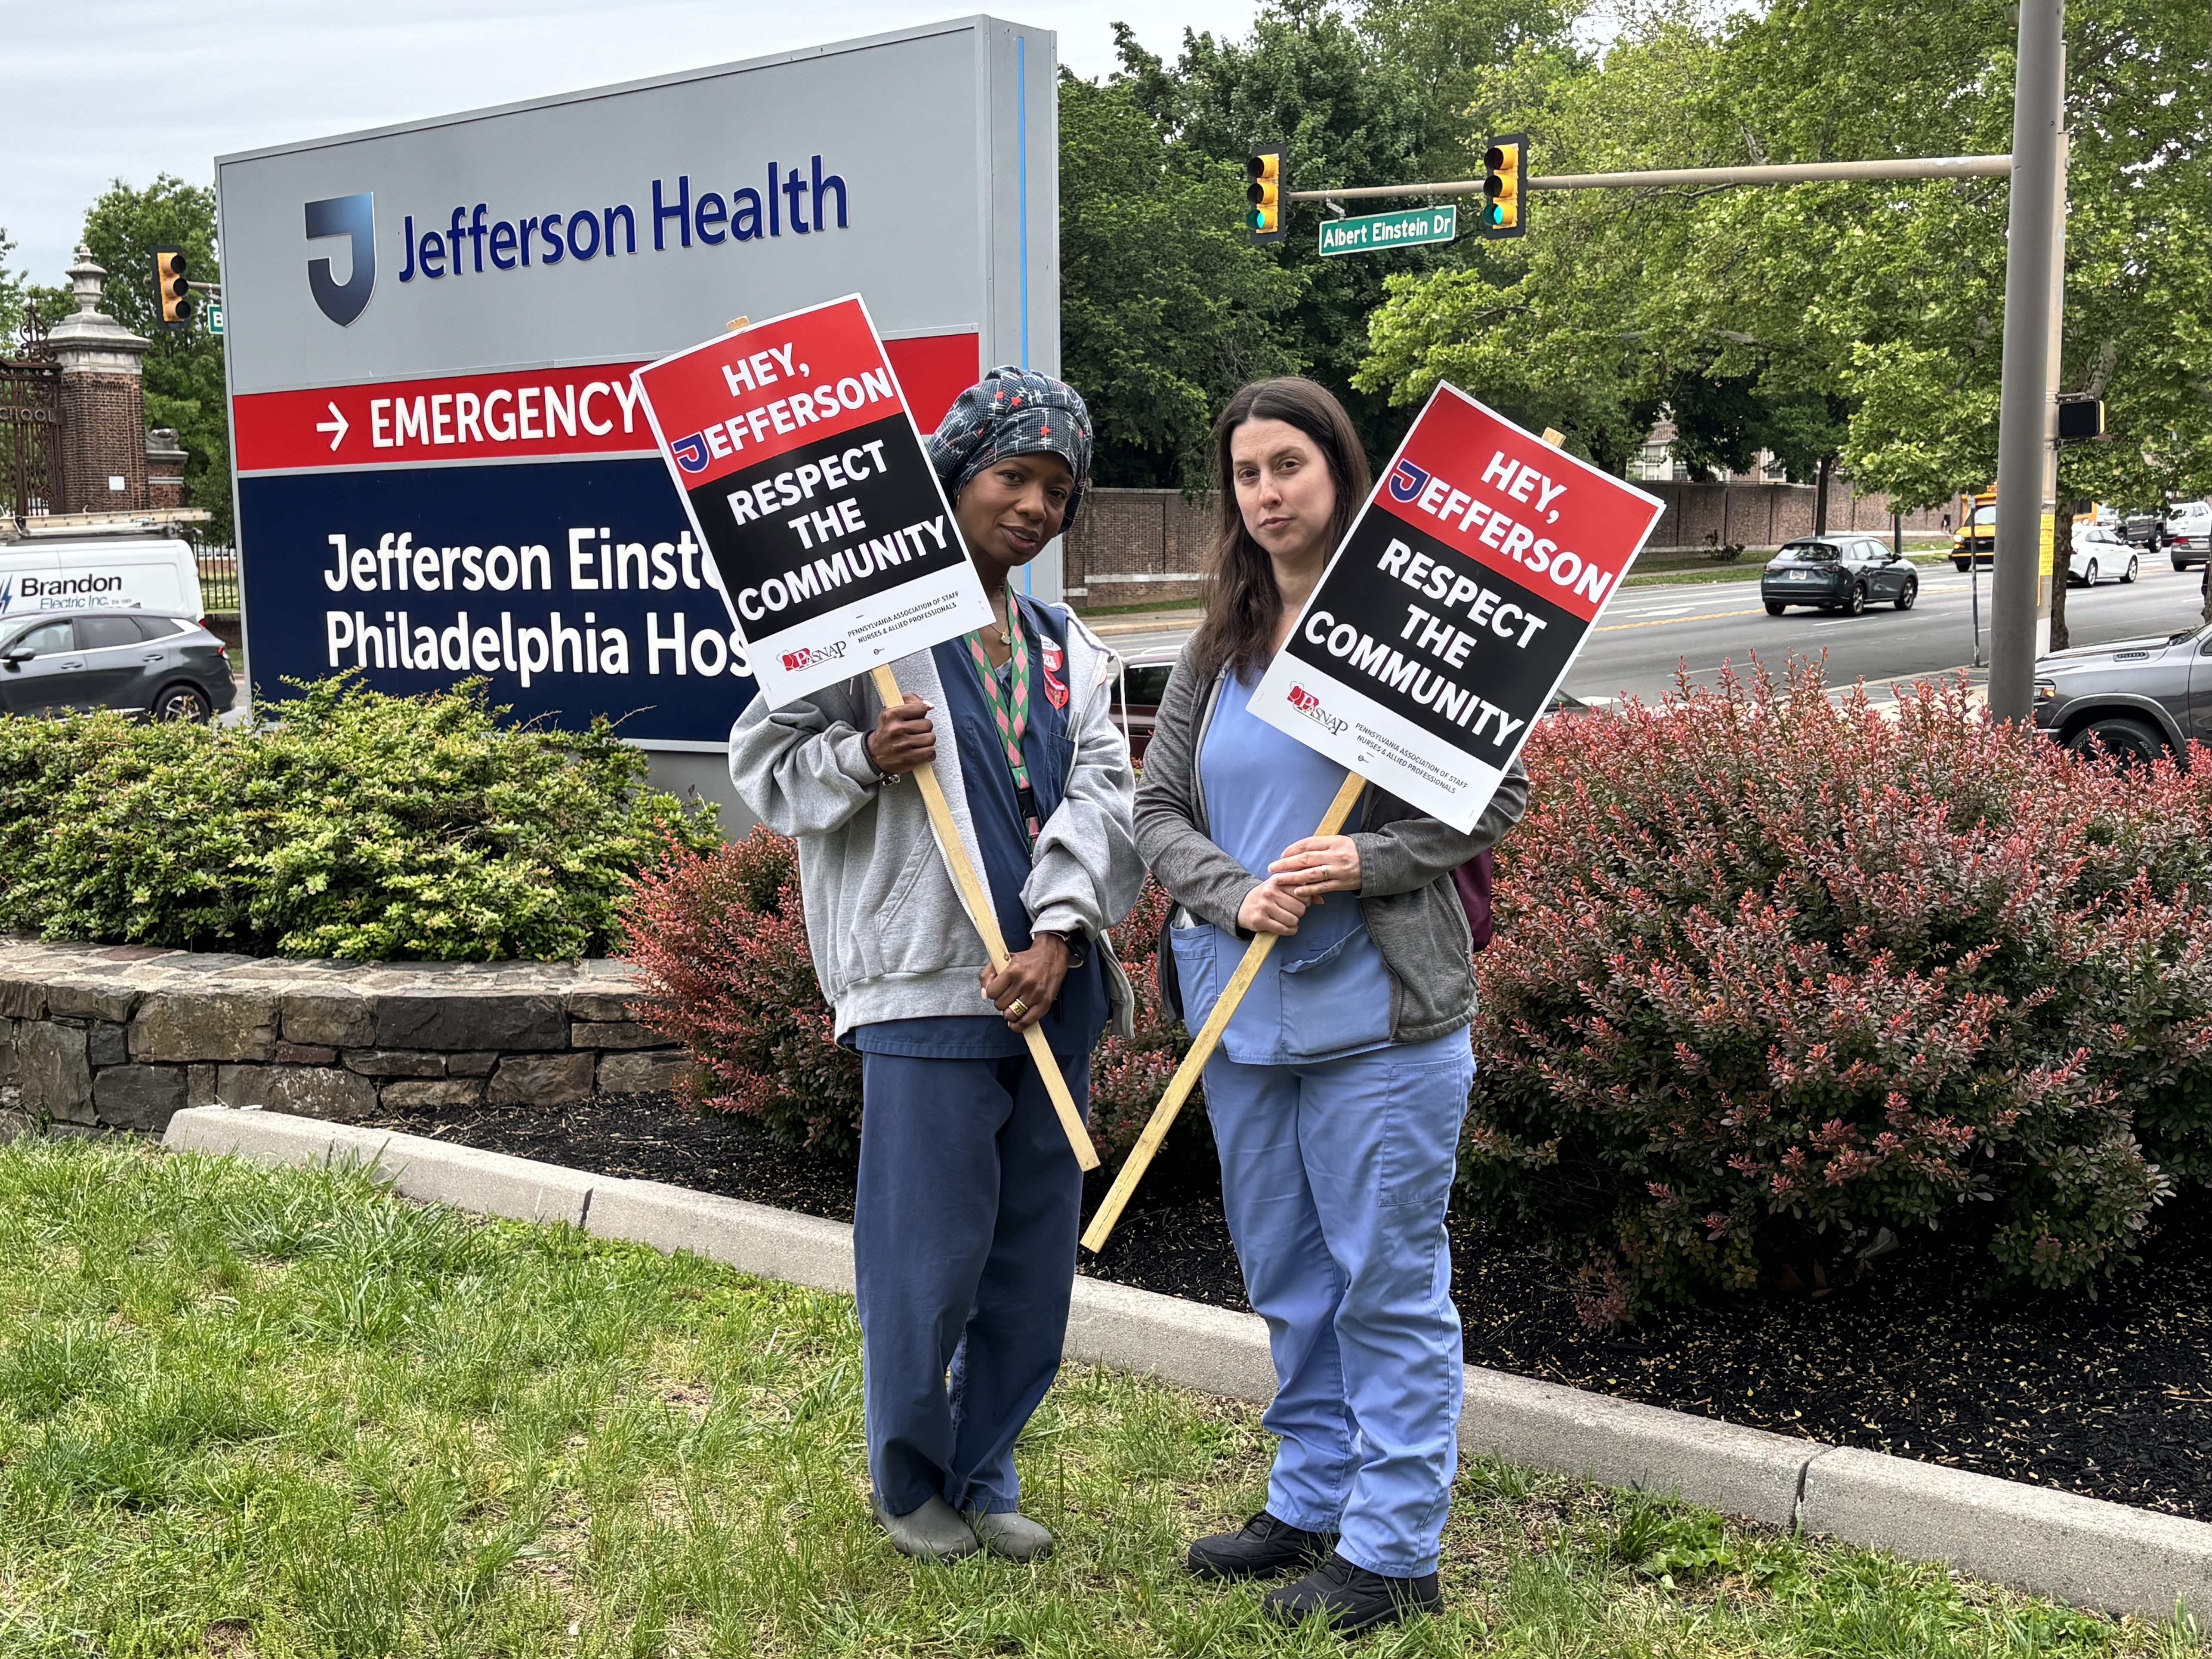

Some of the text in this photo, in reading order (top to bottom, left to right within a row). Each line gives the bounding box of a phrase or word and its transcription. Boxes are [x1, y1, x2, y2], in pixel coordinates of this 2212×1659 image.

[399, 154, 850, 282] Jefferson Health
[1323, 215, 1451, 248] Albert Einstein Dr
[722, 342, 810, 397] HEY,
[370, 381, 638, 448] EMERGENCY
[671, 367, 894, 473] JEFFERSON
[726, 439, 888, 526] RESPECT
[1481, 450, 1567, 524] HEY,
[788, 497, 866, 549] THE
[1389, 458, 1612, 604] JEFFERSON
[21, 574, 122, 597] Brandon
[324, 532, 552, 592] Jefferson
[737, 515, 947, 620] COMMUNITY
[1377, 538, 1547, 648] RESPECT
[40, 595, 86, 609] Electric
[89, 595, 109, 609] Inc.
[848, 616, 892, 638] PENNSYLVANIA
[893, 601, 932, 621] ASSOCIATION
[942, 591, 959, 602] STAFF
[858, 630, 882, 644] NURSES
[889, 620, 908, 632] ALLIED
[909, 602, 957, 625] PROFESSIONALS
[326, 611, 629, 688] Philadelphia
[1400, 604, 1477, 669] THE
[1305, 611, 1524, 746] COMMUNITY
[1356, 723, 1468, 789] PENNSYLVANIA ASSOCIATION OF STAFF
[1357, 735, 1381, 752] NURSES
[1386, 752, 1407, 768] ALLIED
[1407, 763, 1456, 793] PROFESSIONALS
